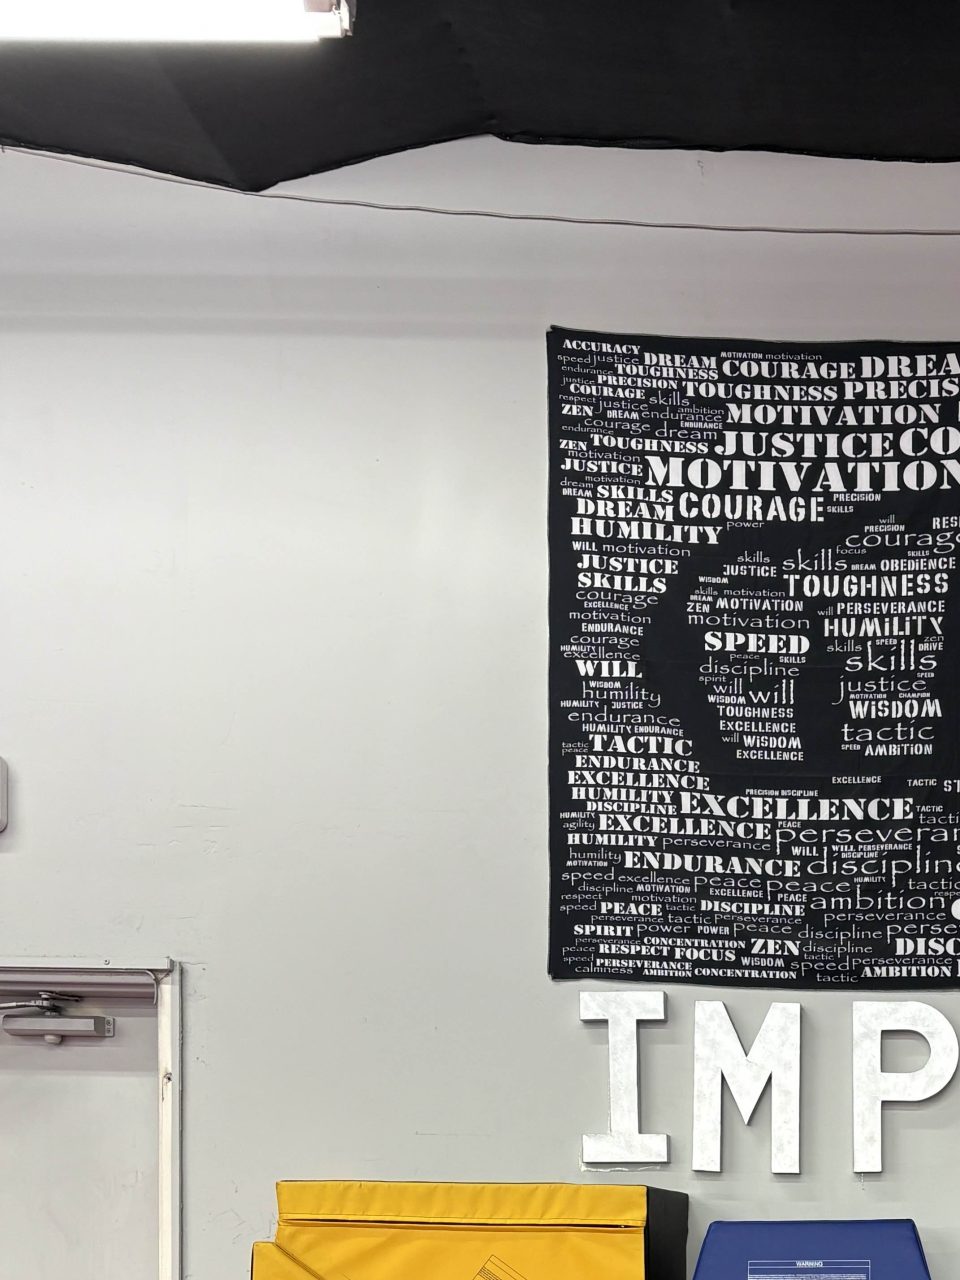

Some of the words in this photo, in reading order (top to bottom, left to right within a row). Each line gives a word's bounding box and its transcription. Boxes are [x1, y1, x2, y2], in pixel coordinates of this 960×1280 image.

[644, 352, 717, 369] DREAM
[722, 359, 856, 380] COURAGE
[682, 381, 838, 401] TOUGHNESS
[726, 403, 941, 426] MOTIVATION
[584, 418, 650, 434] courage
[590, 435, 709, 454] TOUGHNESS
[714, 431, 893, 458] JUSTICE
[576, 498, 675, 522] DREAM
[679, 491, 825, 522] COURAGE
[571, 517, 723, 545] HUMILITY
[577, 554, 679, 575] JUSTICE
[782, 548, 848, 571] skills
[783, 571, 949, 599] TOUGHNESS
[687, 612, 811, 630] motivation
[704, 631, 811, 658] SPEED
[826, 638, 862, 653] skills
[845, 638, 938, 673] skills
[575, 659, 643, 679] WILL
[699, 655, 800, 683] discipline
[831, 674, 928, 706] justice
[567, 705, 681, 728] endurance
[589, 733, 693, 758] TACTIC
[575, 754, 701, 774] ENDURANCE
[568, 770, 711, 792] EXCELLENCE
[571, 787, 674, 804] HUMILITY
[679, 790, 914, 821] EXCELLENCE
[599, 813, 771, 840] EXCELLENCE
[662, 837, 772, 851] perseverance
[624, 850, 801, 878] ENDURANCE
[561, 866, 615, 887] speed
[700, 899, 806, 917] DISCIPLINE
[810, 885, 947, 911] ambition
[637, 922, 691, 937] power
[694, 967, 797, 980] CONCENTRATION
[796, 1260, 824, 1268] WARNING
